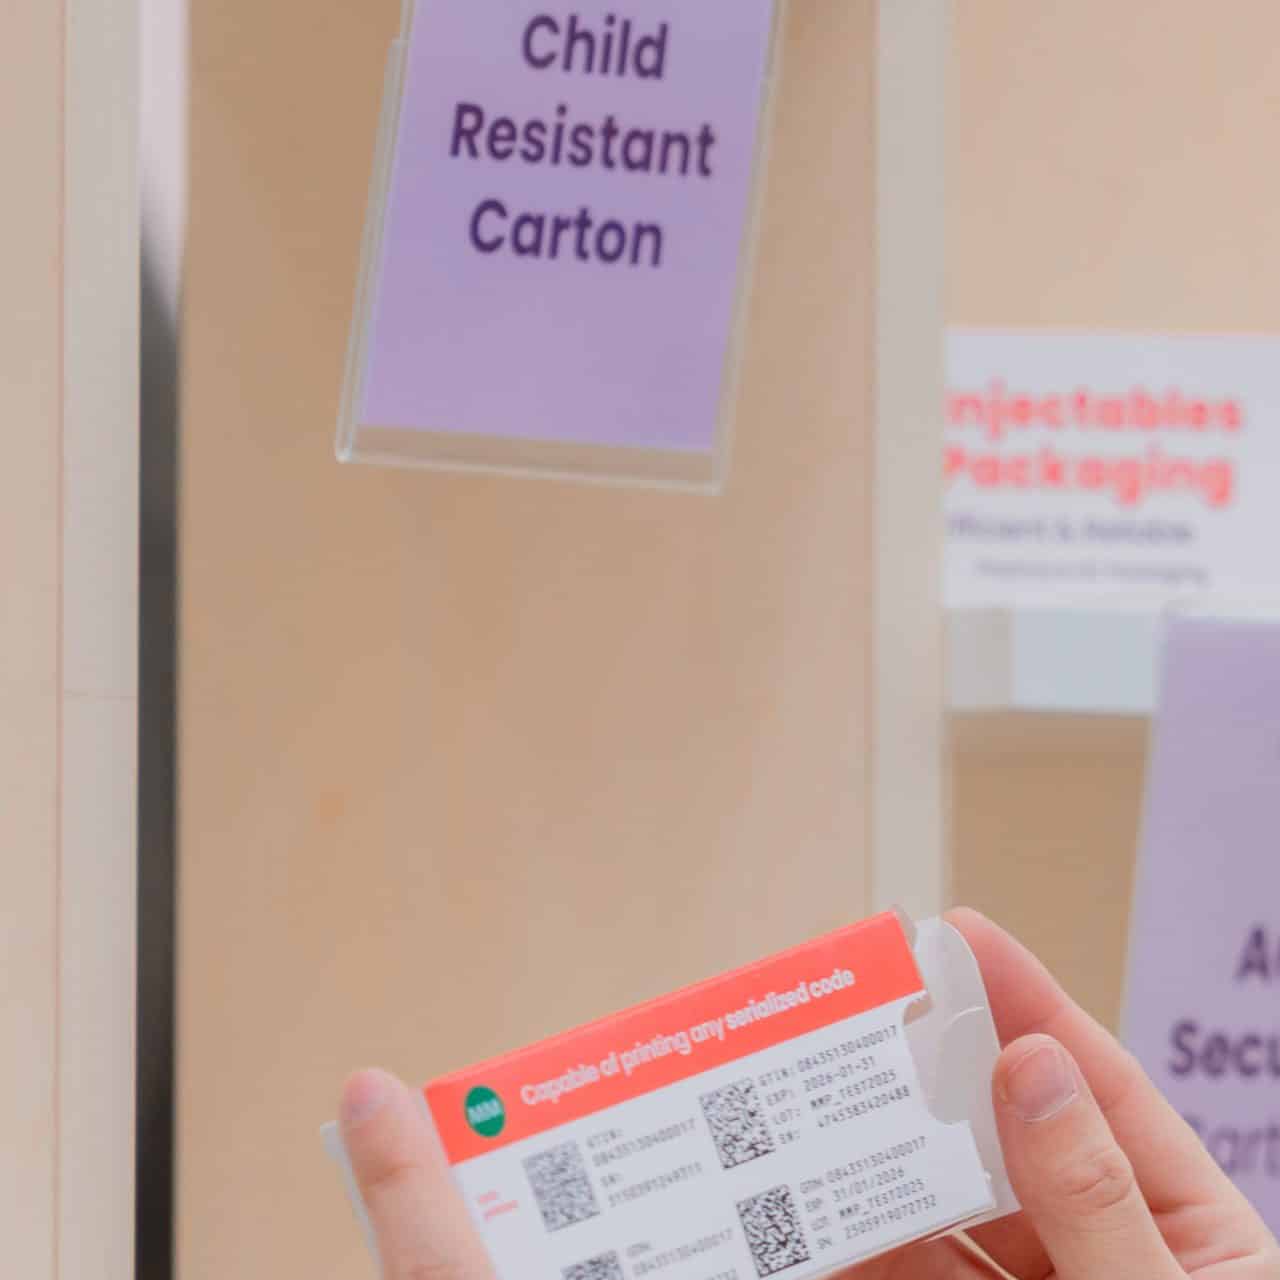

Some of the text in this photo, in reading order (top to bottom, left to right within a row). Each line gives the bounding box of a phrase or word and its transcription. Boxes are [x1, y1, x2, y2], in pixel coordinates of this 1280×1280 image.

[520, 13, 670, 80] Child
[449, 101, 716, 178] Resistant
[468, 198, 664, 268] Carton
[946, 380, 1243, 441] njectables
[520, 968, 856, 1104] Capable of printing any serialized code
